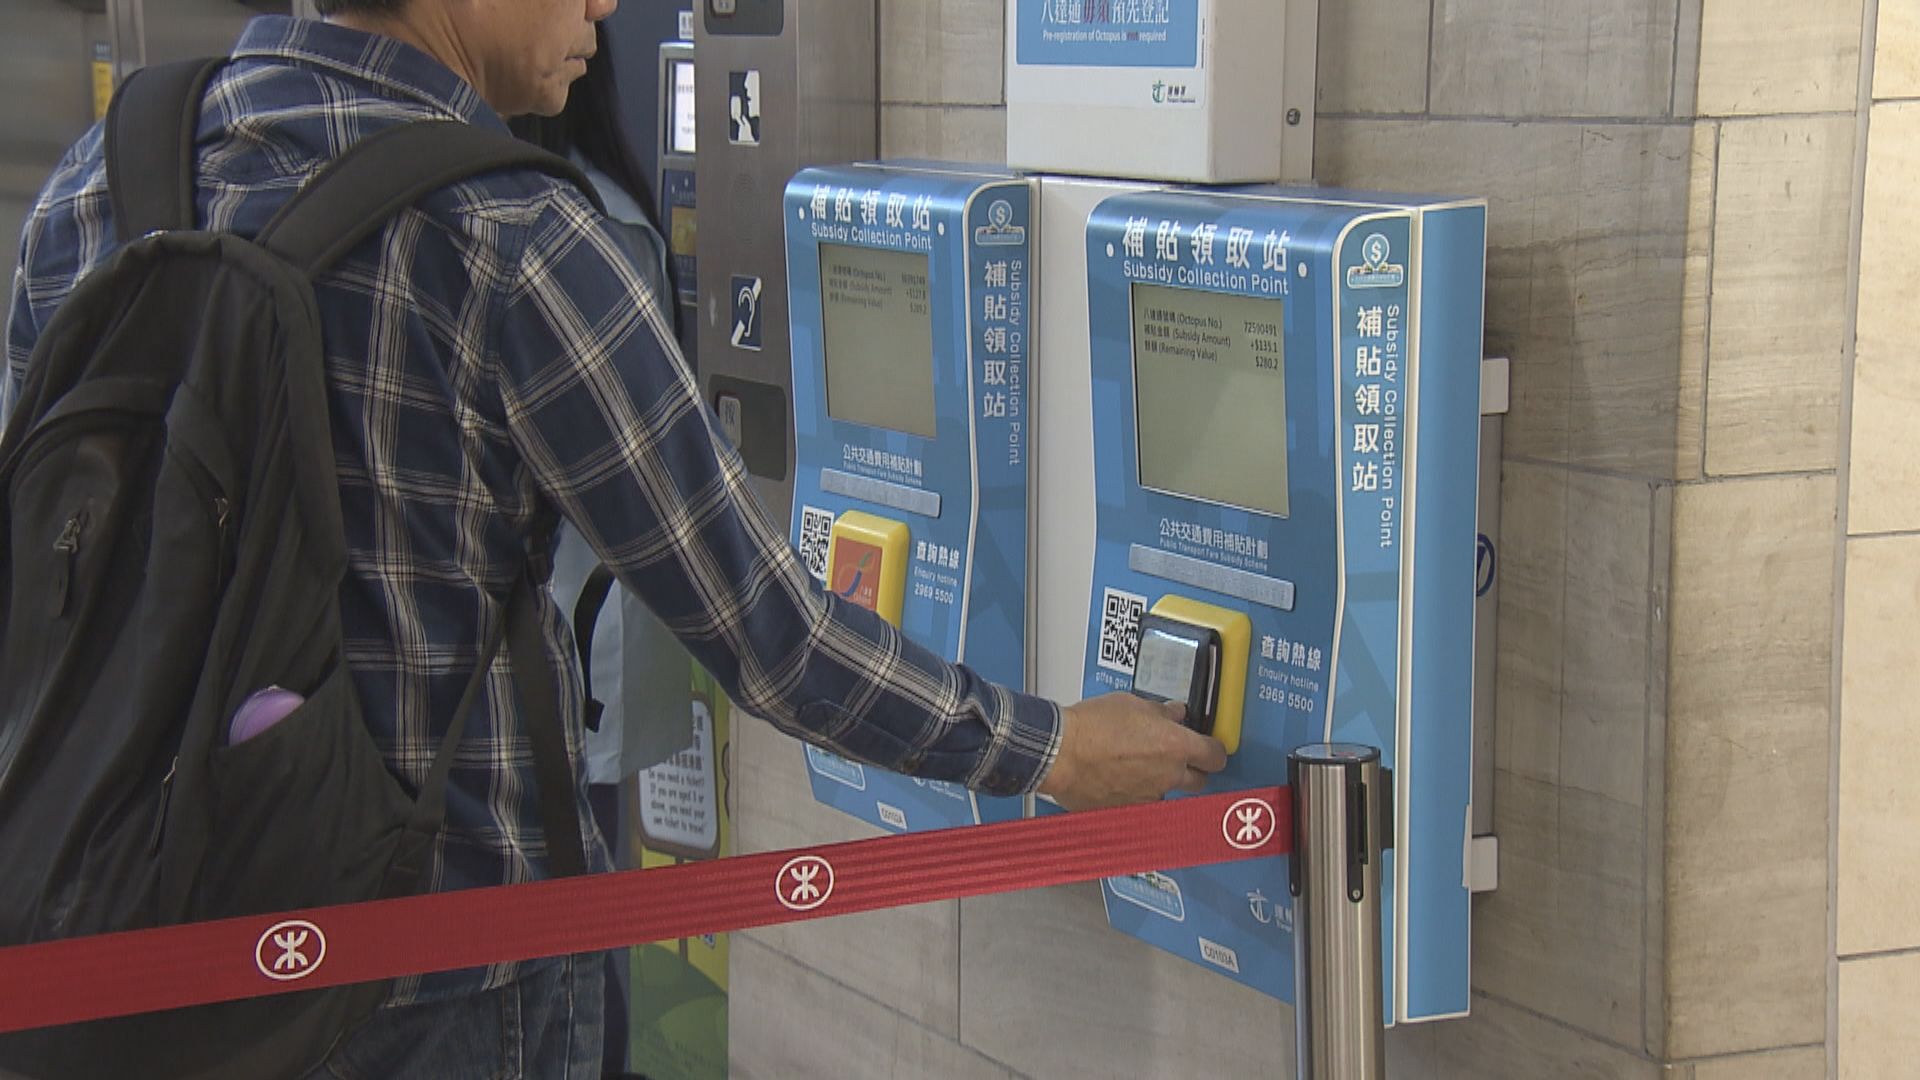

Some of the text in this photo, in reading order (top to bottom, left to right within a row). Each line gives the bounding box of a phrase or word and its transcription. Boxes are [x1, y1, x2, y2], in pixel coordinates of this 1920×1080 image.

[1042, 30, 1087, 44] Pre-registration
[1088, 30, 1095, 41] of
[1096, 30, 1120, 44] Octopus
[1122, 30, 1127, 41] is
[1139, 30, 1167, 44] required
[810, 184, 933, 231] 補貼領取站
[812, 222, 932, 250] Subsidy Collection Point
[1122, 216, 1290, 272] 補貼領取站
[1123, 260, 1289, 295] Subsidy Collection Point
[1177, 313, 1207, 329] (Octopus
[984, 260, 1008, 418] 補貼領取站
[1158, 342, 1196, 361] (Remaining
[1196, 347, 1218, 362] Value)
[1172, 327, 1201, 345] (Subsidy
[1202, 332, 1231, 348] Amount)
[1008, 260, 1022, 466] Subsidy Collection Point
[1352, 305, 1383, 492] 補貼領取站
[1380, 304, 1400, 549] Subsidy Collection Point
[916, 540, 960, 570] 查詢熱線
[1159, 518, 1269, 560] 公共交通費用補貼計劃
[914, 584, 954, 604] 2969 5500
[1260, 634, 1322, 671] 查詢熱線
[1258, 665, 1319, 693] Enquiry hotline
[1258, 684, 1314, 713] 2969 5500
